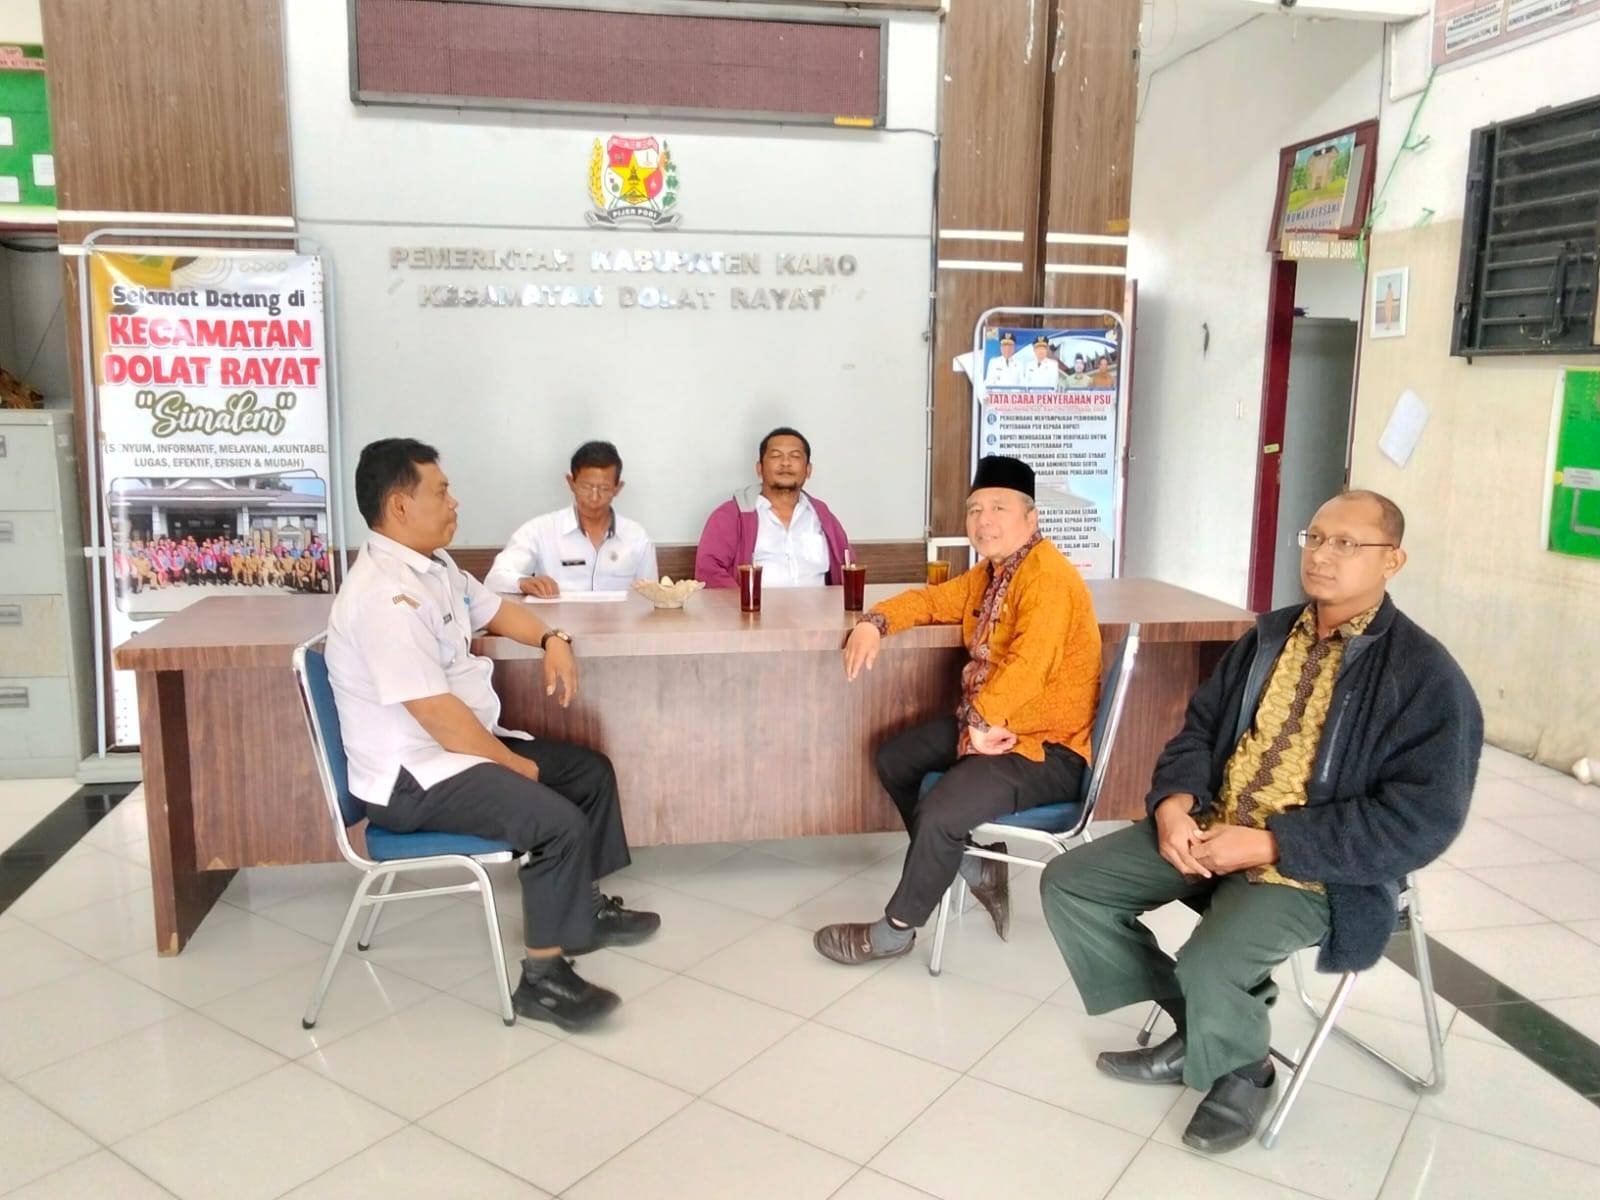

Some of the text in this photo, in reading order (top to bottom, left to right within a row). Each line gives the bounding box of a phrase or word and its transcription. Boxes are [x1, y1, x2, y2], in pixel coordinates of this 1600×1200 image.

[389, 246, 857, 277] PEMERINTAH KABUPATEN KARO
[113, 286, 305, 316] Selamat Datang di
[418, 283, 827, 311] KECAMATAN DOLAT RAYAT
[108, 316, 313, 349] KECAMATAN
[104, 354, 321, 386] DOLAT RAYAT
[989, 394, 1111, 405] TATA CARA PENYERAHAN PSU
[134, 457, 305, 469] LUGAS, EFEKTIF, EFISIEN & MUDAH)
[156, 444, 217, 455] INFORMATIF,
[219, 444, 271, 455] MELAYANI,
